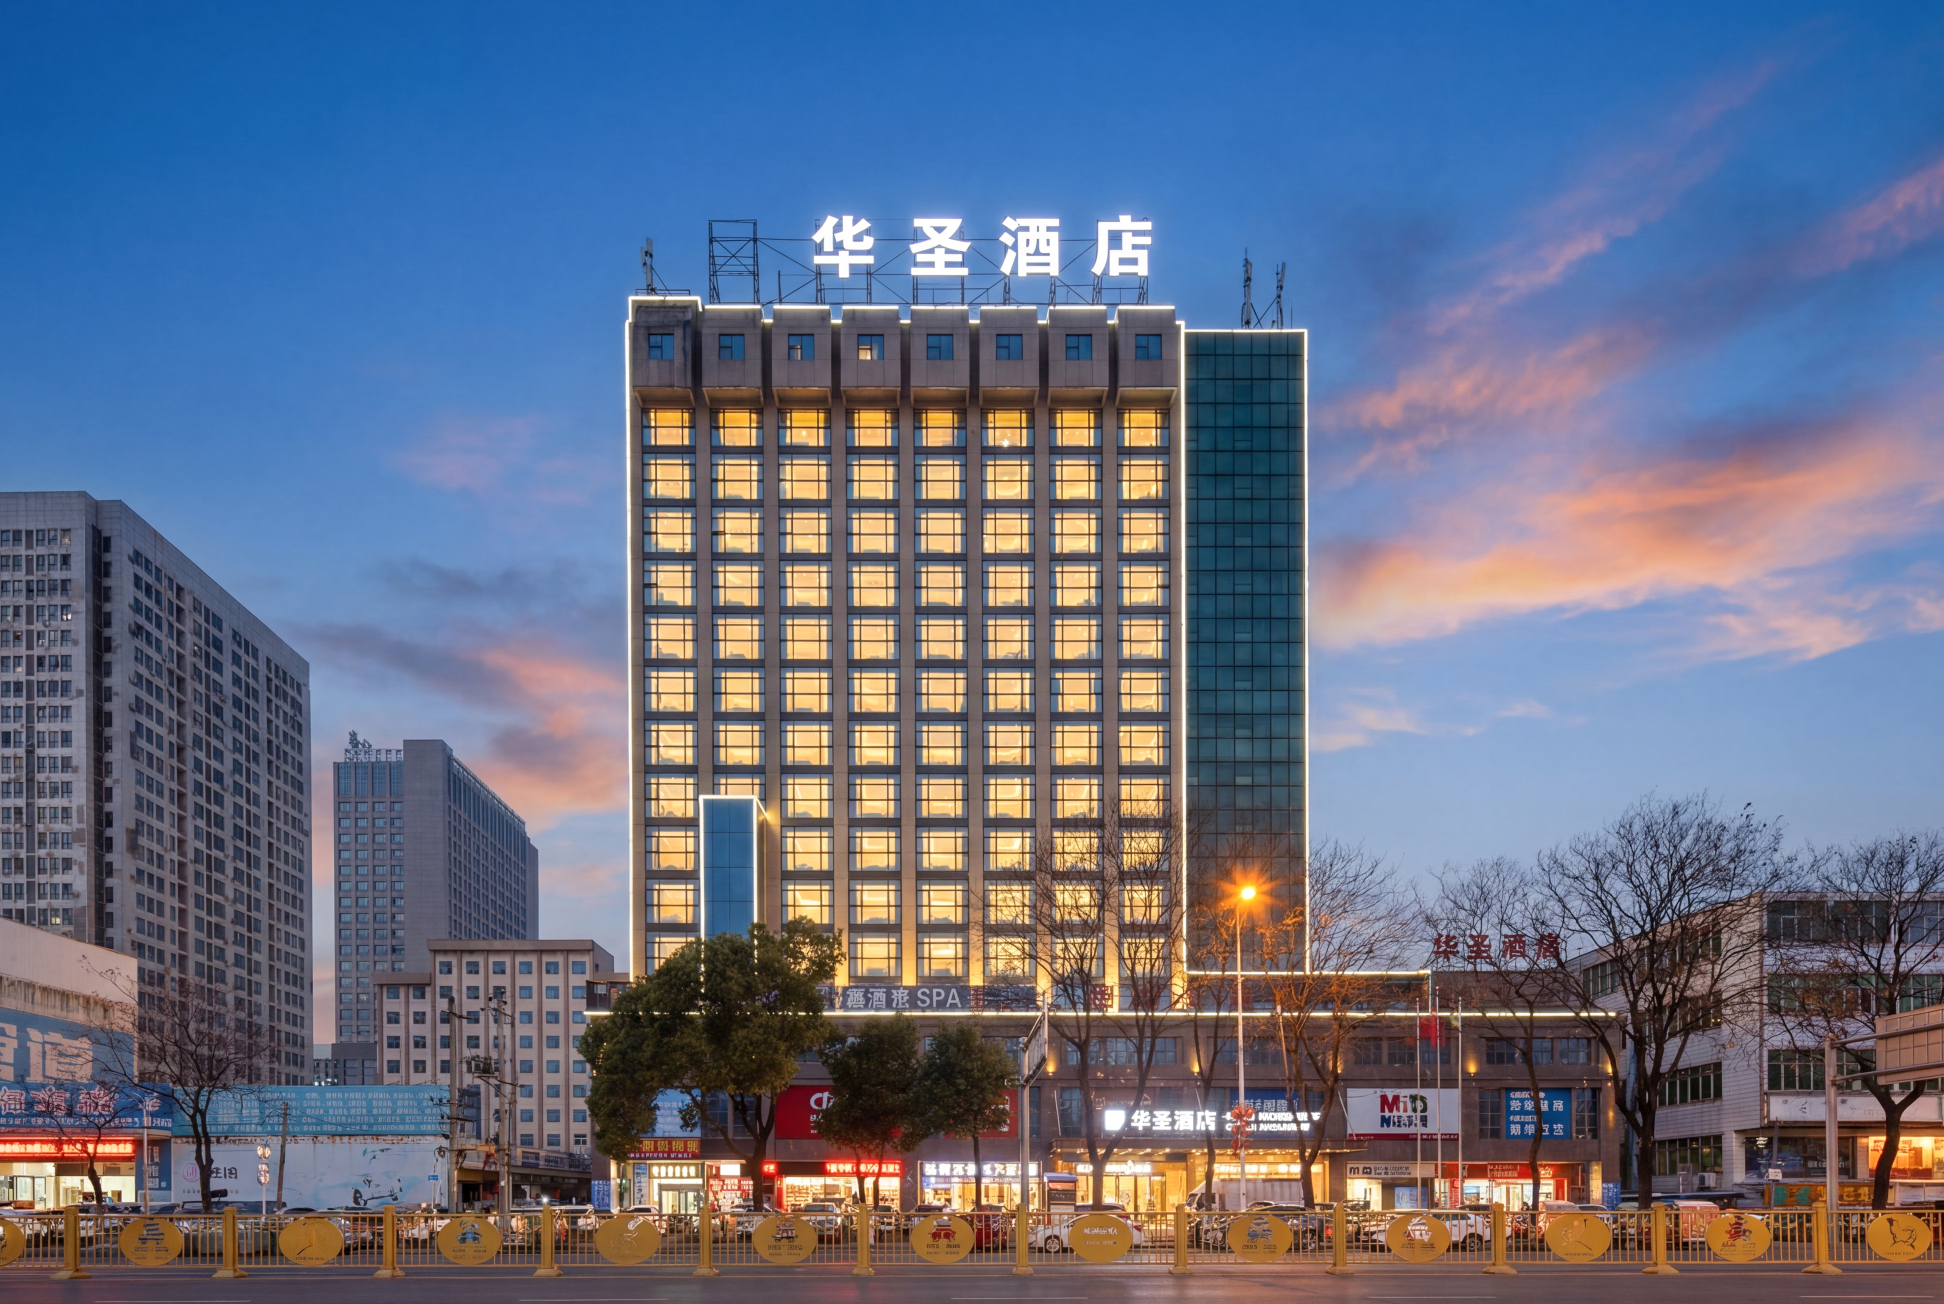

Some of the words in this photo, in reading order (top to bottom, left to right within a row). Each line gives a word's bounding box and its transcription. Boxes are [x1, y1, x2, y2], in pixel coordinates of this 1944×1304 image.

[812, 215, 1152, 278] 华圣酒店
[917, 988, 962, 1008] SPA
[1131, 1109, 1216, 1131] 华圣酒店
